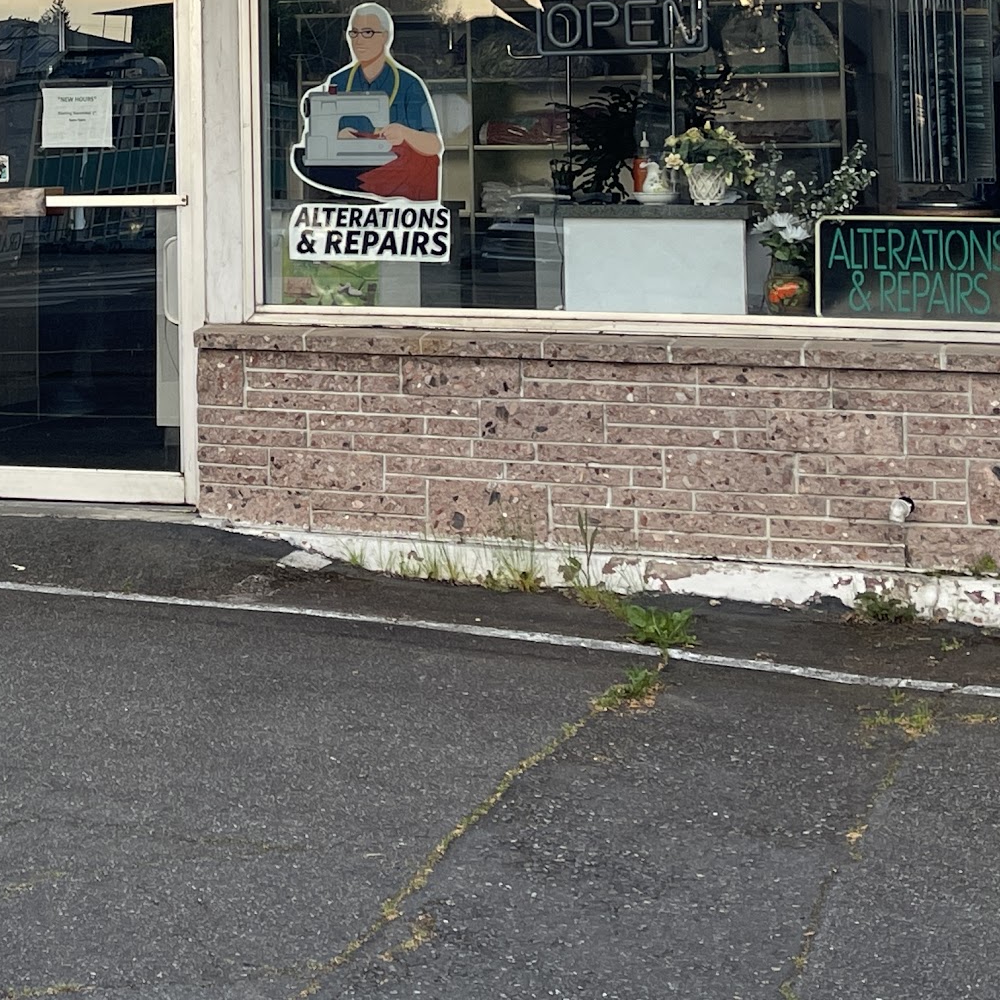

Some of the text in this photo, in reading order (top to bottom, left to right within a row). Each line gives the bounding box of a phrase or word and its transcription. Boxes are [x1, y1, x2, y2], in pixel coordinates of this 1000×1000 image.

[294, 206, 449, 229] ALTERATIONS
[296, 229, 449, 256] & REPAIRS
[849, 270, 991, 315] & REPAIRS
